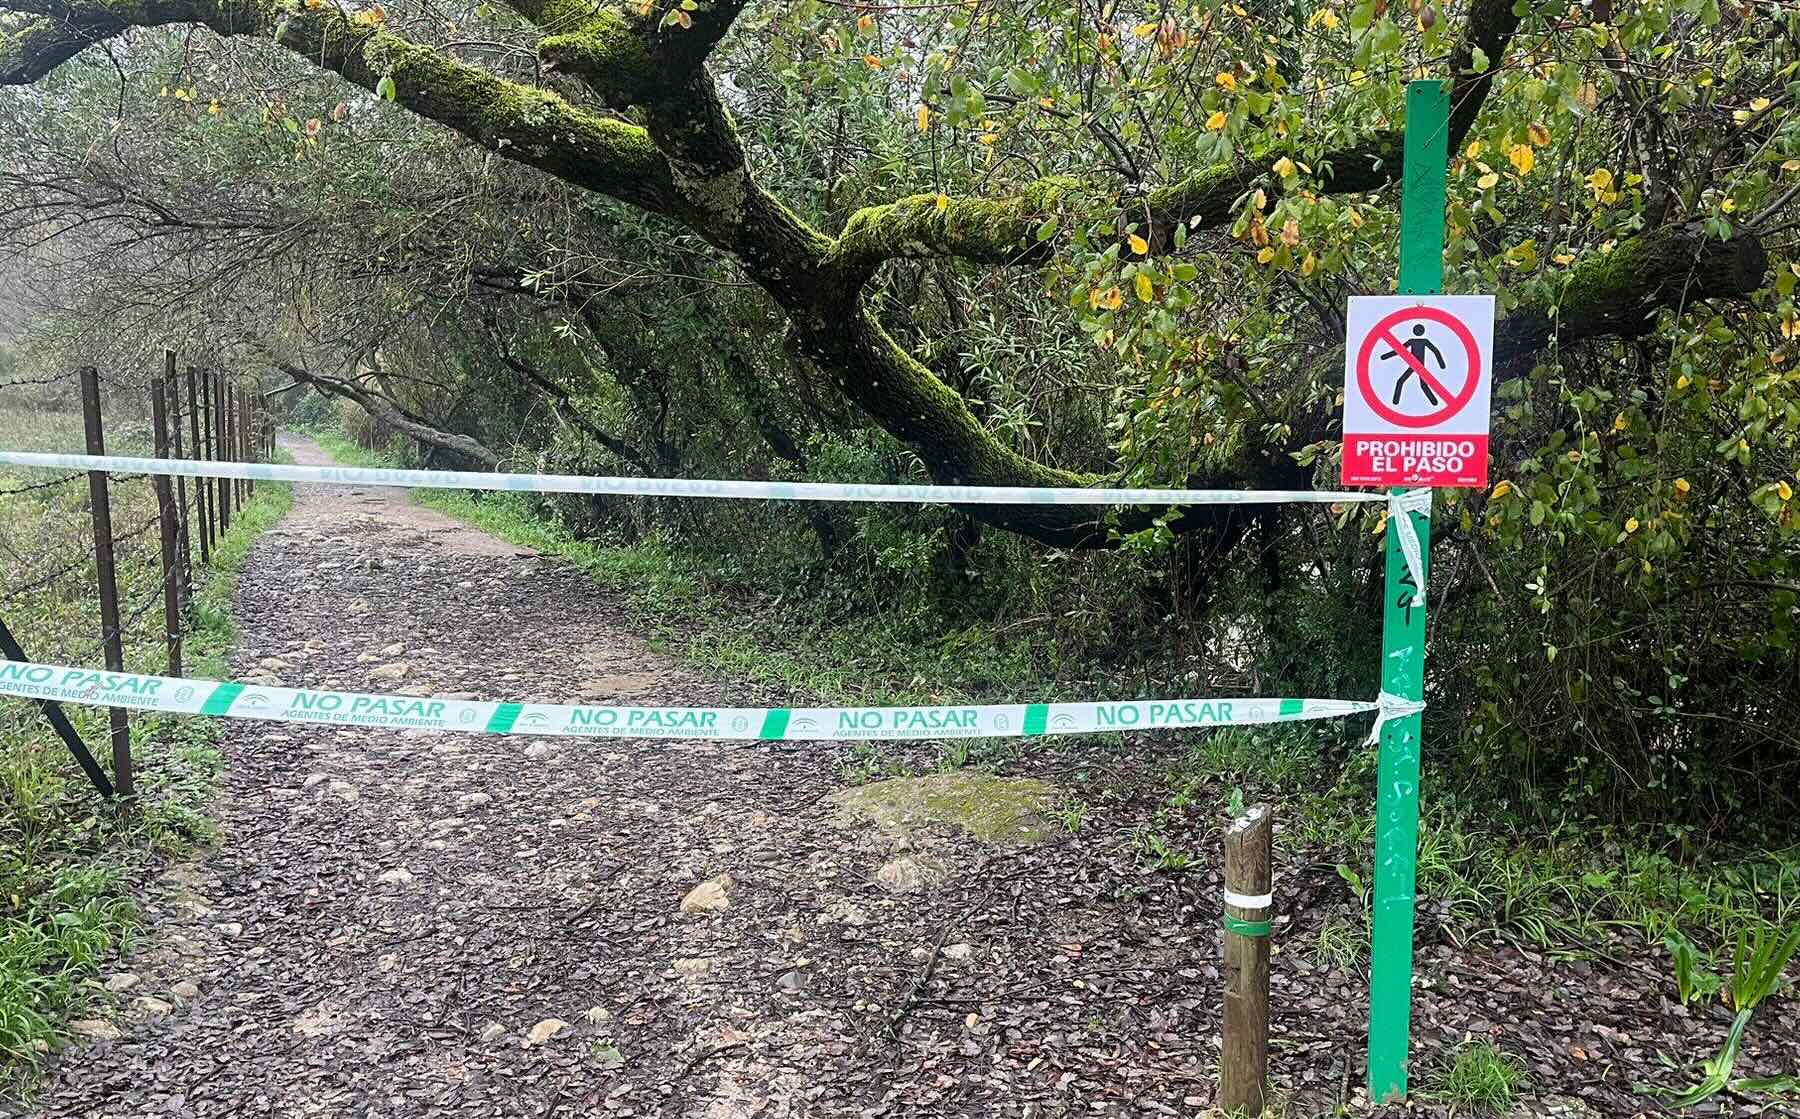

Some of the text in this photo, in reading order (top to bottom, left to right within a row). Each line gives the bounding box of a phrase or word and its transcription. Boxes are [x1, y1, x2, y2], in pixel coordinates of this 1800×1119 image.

[1356, 441, 1475, 457] PROHIBIDO
[1372, 457, 1463, 472] EL PASO
[0, 664, 163, 695] NO PASAR
[0, 681, 160, 706] GENTES DE MEDIO AMBIENTE
[291, 692, 446, 718] NO PASAR
[1096, 702, 1233, 726] NO PASAR
[281, 709, 446, 727] AGENTES DE MEDIO AMBIENTE
[570, 709, 718, 728] NO PASAR
[838, 709, 978, 728] NO PASAR
[562, 725, 720, 737] AGENTES DE MEDIO AMBIENTE
[833, 728, 983, 738] AGENTES DE MEDIO AMBIENTE
